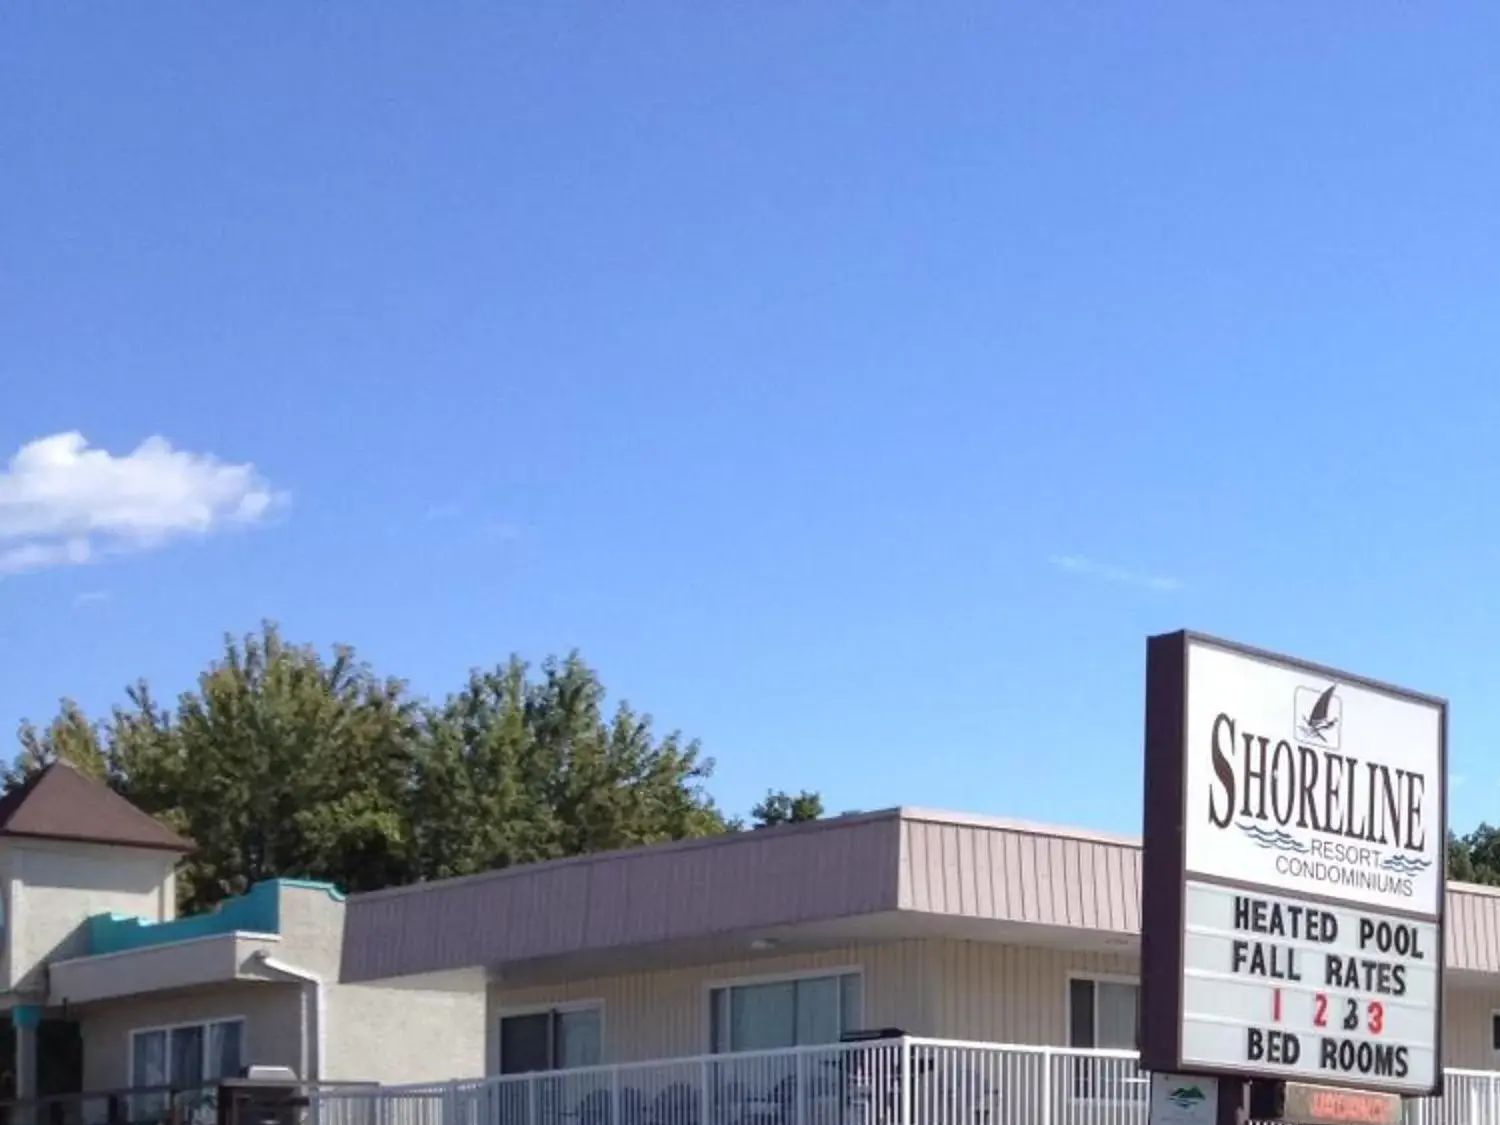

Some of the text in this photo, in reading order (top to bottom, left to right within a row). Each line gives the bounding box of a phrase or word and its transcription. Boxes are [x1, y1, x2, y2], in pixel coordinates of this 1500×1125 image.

[1208, 712, 1425, 852] SHORELINE
[1275, 855, 1413, 897] CONDOMINIUMS
[1310, 839, 1382, 868] RESORT
[1234, 896, 1424, 959] HEATED POOL
[1232, 940, 1406, 996] FALL RATES
[1272, 988, 1281, 1022] 1
[1313, 993, 1327, 1028] 2
[1367, 1001, 1383, 1034] 3
[1247, 1028, 1409, 1078] BED ROOMS
